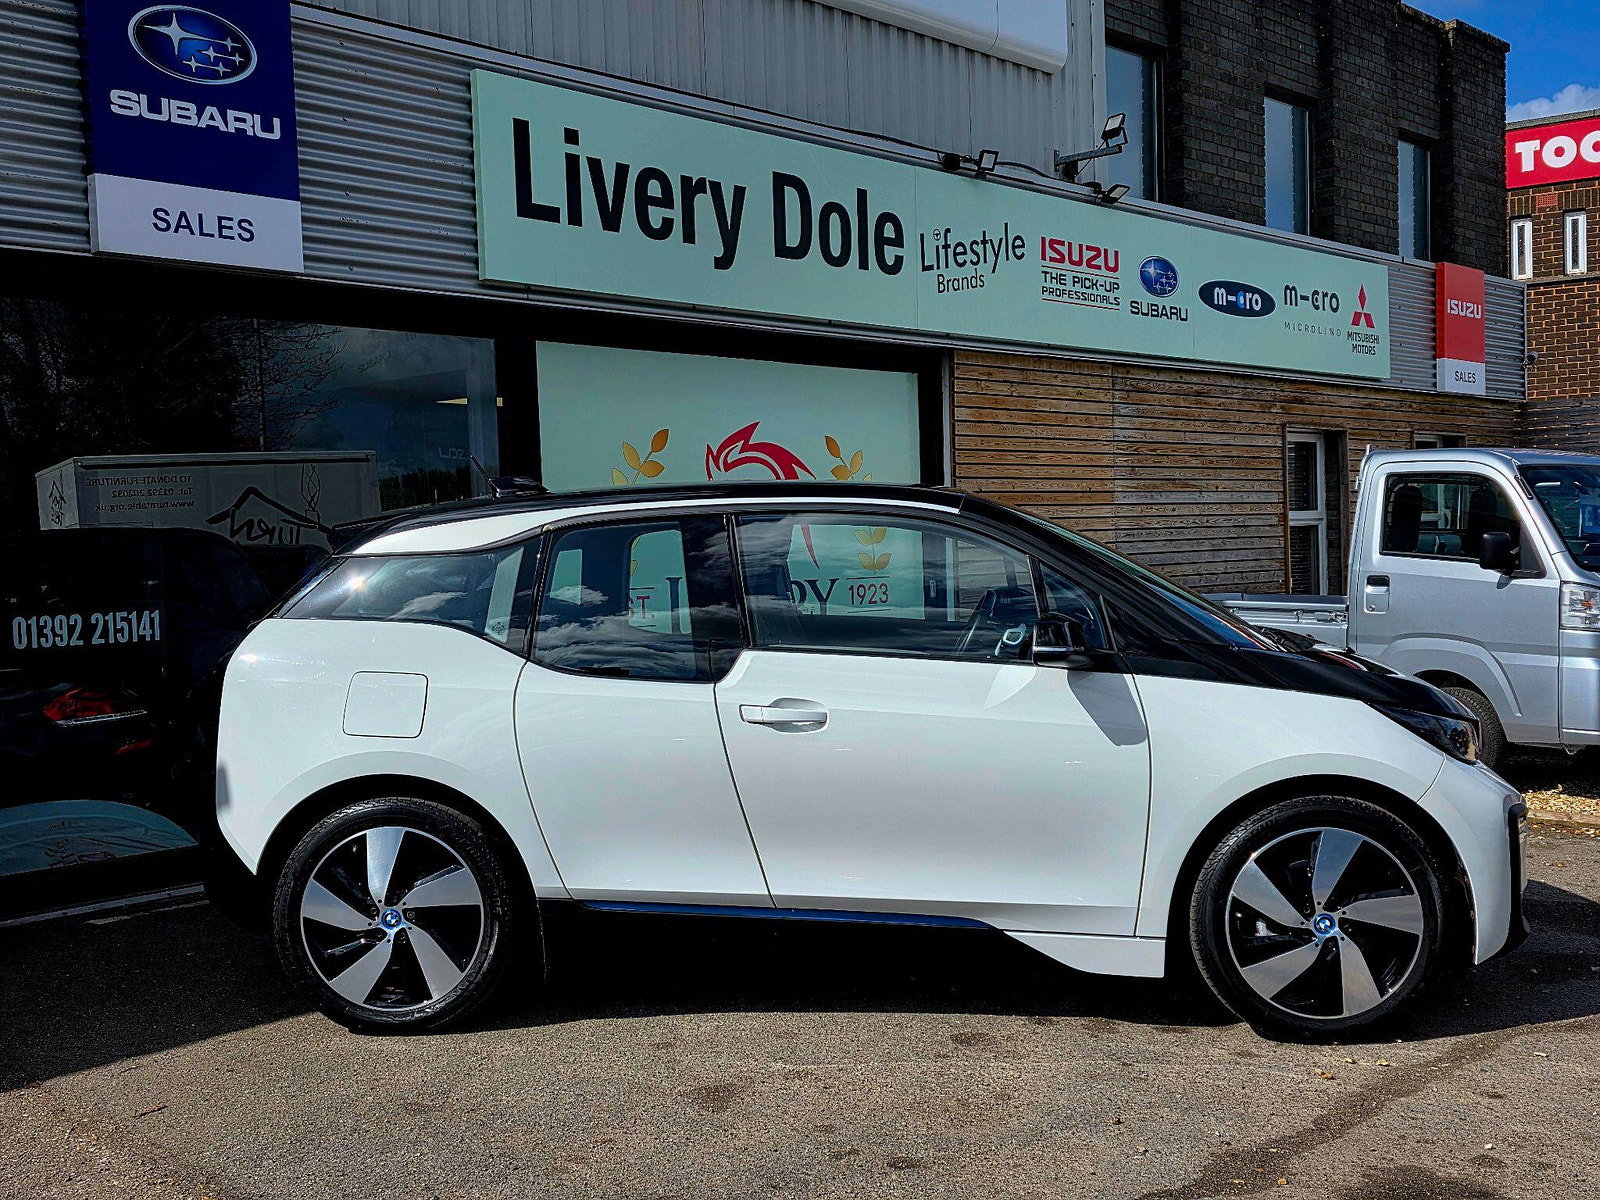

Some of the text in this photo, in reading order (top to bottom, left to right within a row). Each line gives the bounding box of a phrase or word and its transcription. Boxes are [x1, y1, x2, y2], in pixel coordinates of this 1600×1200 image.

[109, 89, 281, 140] SUBARU
[512, 117, 904, 276] Livery Dole
[151, 207, 255, 242] SALES
[919, 222, 1026, 274] Lifestyle
[1040, 236, 1120, 273] ISUZU
[937, 268, 985, 294] Brands
[1041, 271, 1120, 293] THE PICK-UP
[1041, 286, 1120, 306] PROFESSIONALS
[1129, 301, 1188, 322] SUBARU
[1447, 298, 1482, 319] ISUZU
[1284, 320, 1342, 337] MICROLINO
[1347, 330, 1380, 345] MITSUBISHI
[1352, 343, 1376, 355] MOTORS
[1454, 370, 1476, 383] SALES
[848, 583, 889, 605] 1923
[12, 610, 161, 649] 01392 215141
